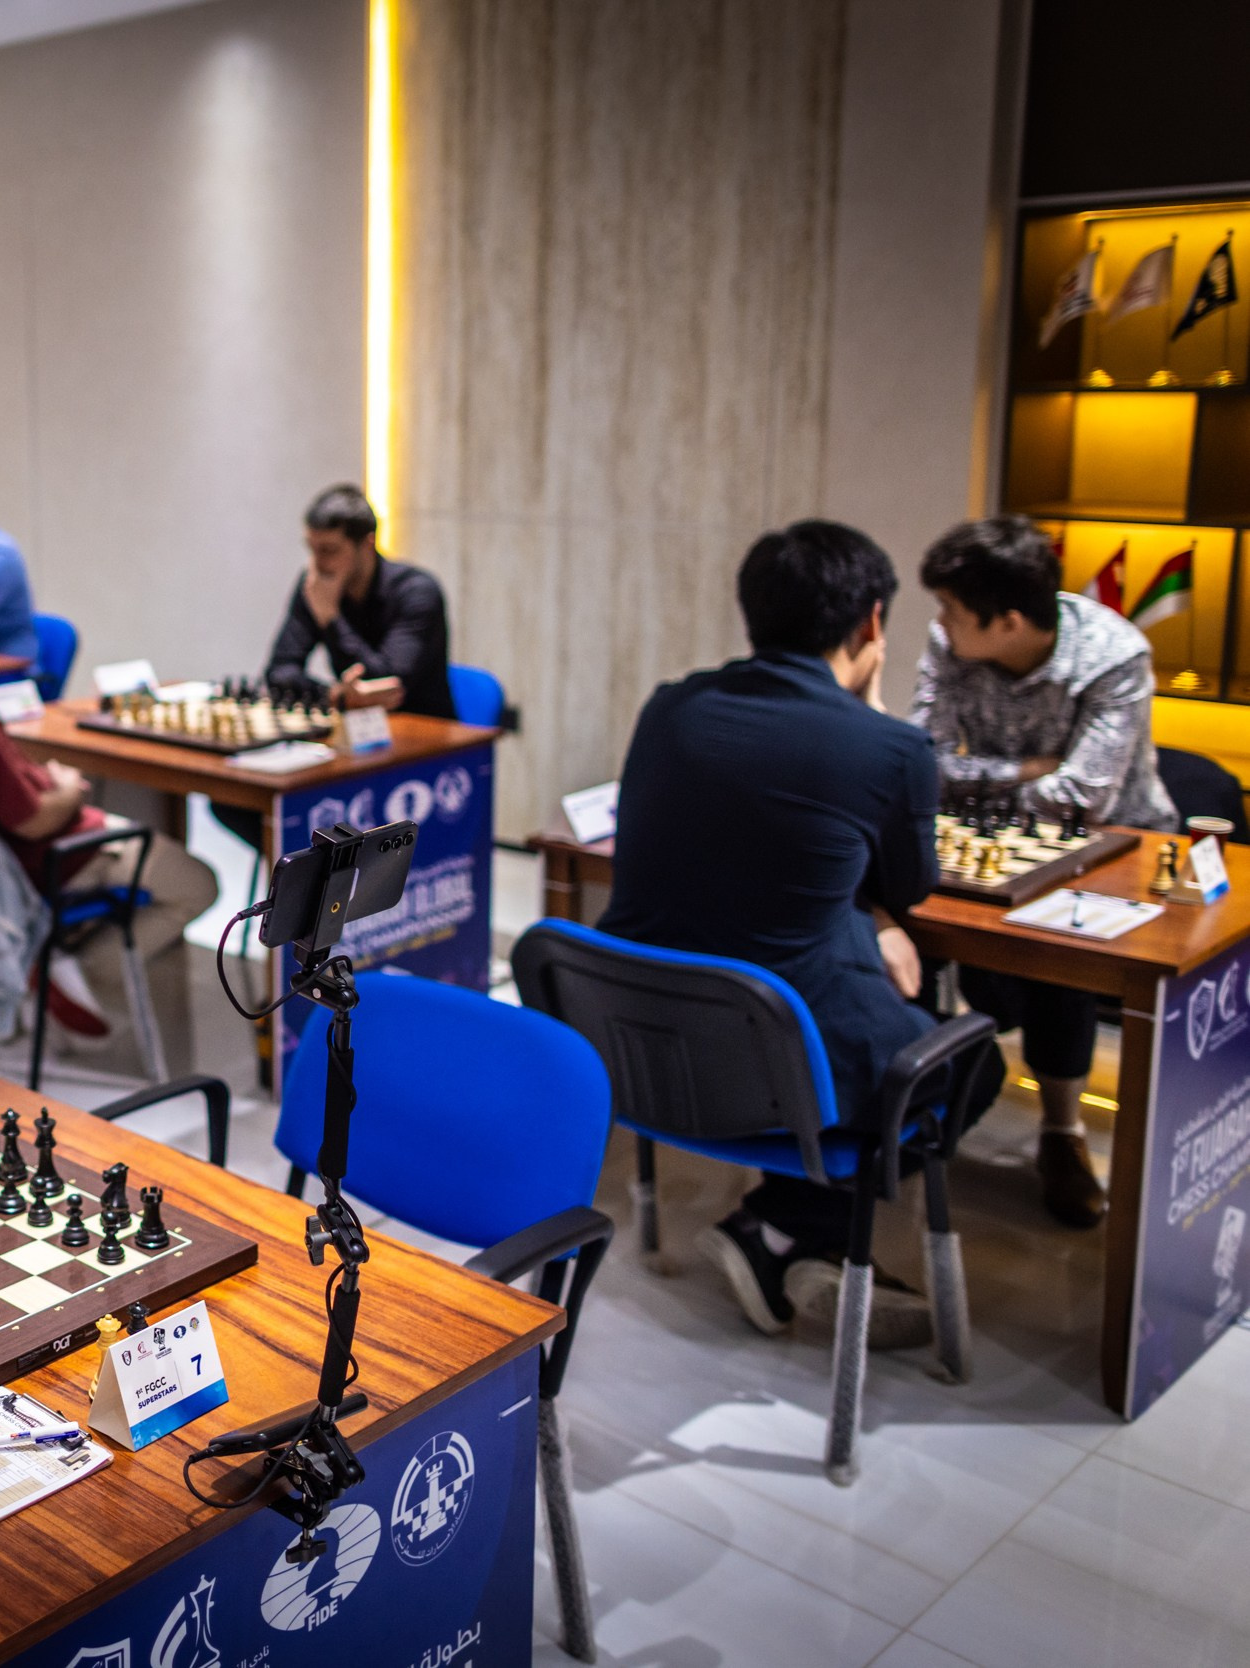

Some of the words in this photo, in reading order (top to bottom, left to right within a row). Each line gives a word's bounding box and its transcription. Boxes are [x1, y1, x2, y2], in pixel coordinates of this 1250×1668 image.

[53, 1334, 72, 1353] DGT
[190, 1353, 202, 1376] 7
[145, 1376, 167, 1394] FGCC
[138, 1384, 177, 1410] SUPERSTARS
[307, 1598, 339, 1633] FIDE
